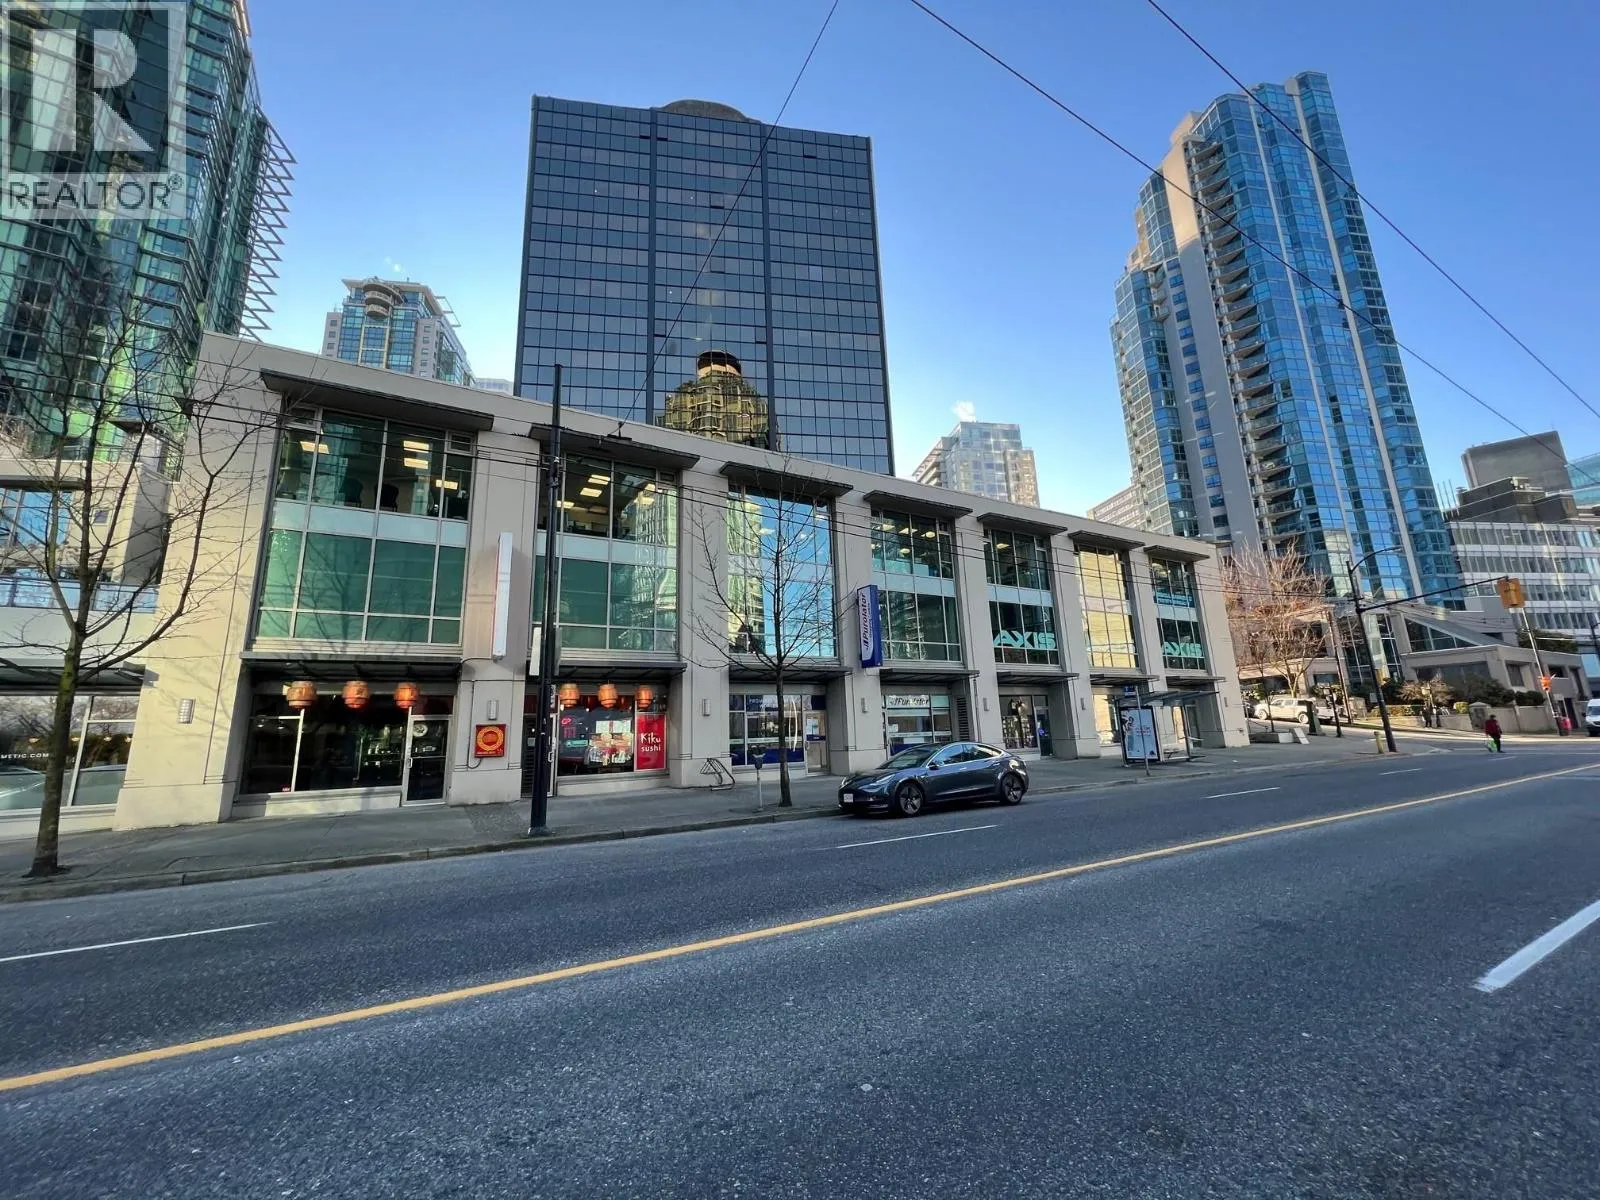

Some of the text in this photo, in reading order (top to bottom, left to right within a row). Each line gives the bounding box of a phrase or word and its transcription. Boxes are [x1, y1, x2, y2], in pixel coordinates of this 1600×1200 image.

[861, 593, 869, 641] Purolator
[993, 630, 1056, 649] AXIS
[1162, 641, 1203, 656] AXIS
[640, 732, 662, 744] Kiku
[641, 745, 662, 753] sushi
